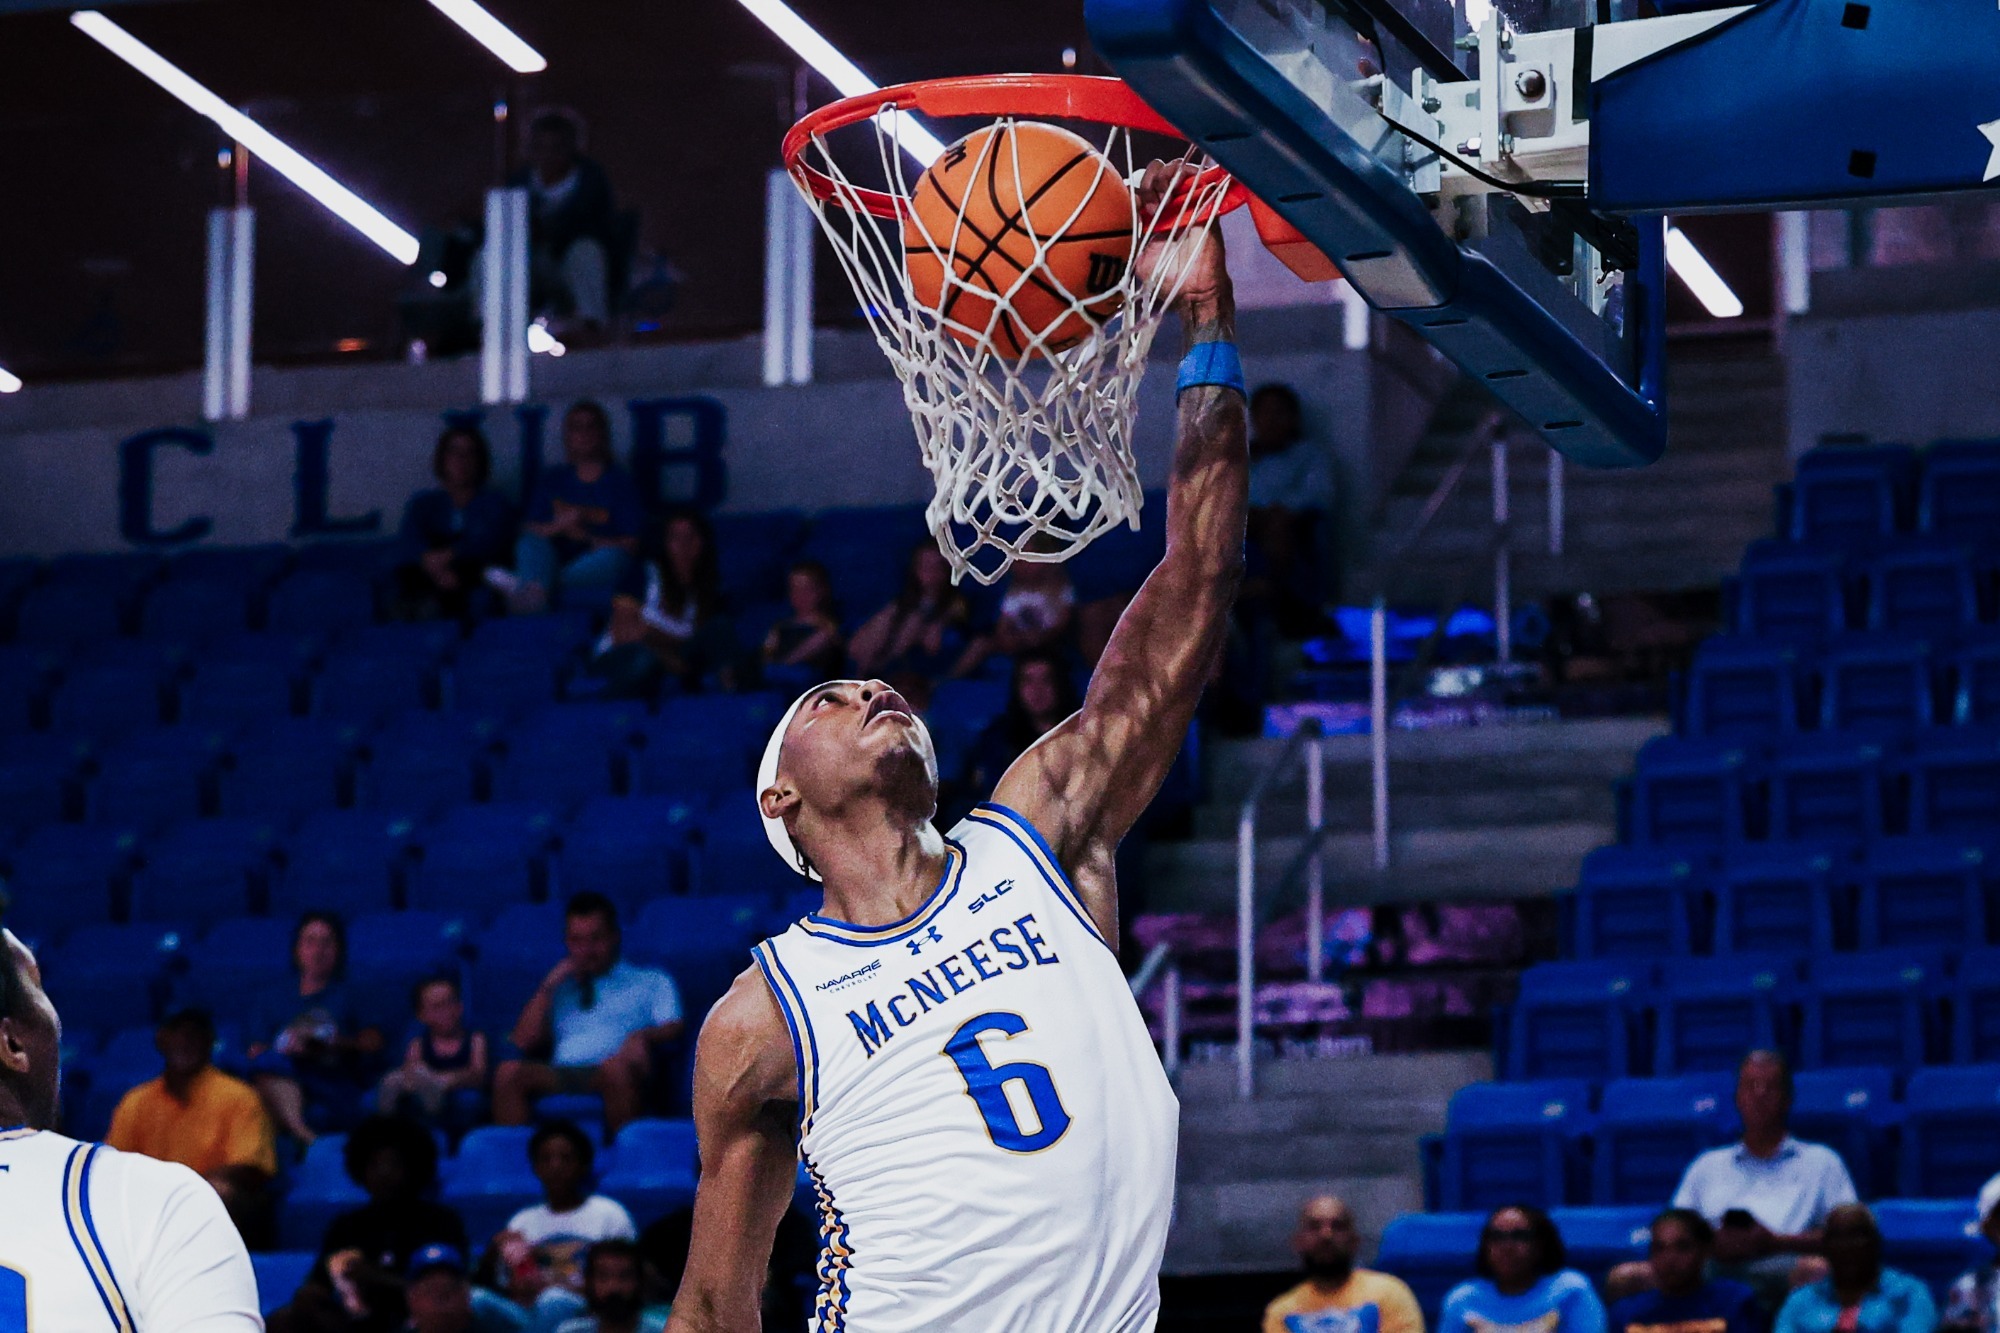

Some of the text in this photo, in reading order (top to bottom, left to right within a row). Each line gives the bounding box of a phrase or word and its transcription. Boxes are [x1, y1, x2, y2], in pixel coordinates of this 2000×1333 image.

[968, 879, 1015, 914] SLC
[815, 958, 882, 992] NAVARRE
[845, 913, 1060, 1060] McNEESE
[938, 1008, 1075, 1156] 6
